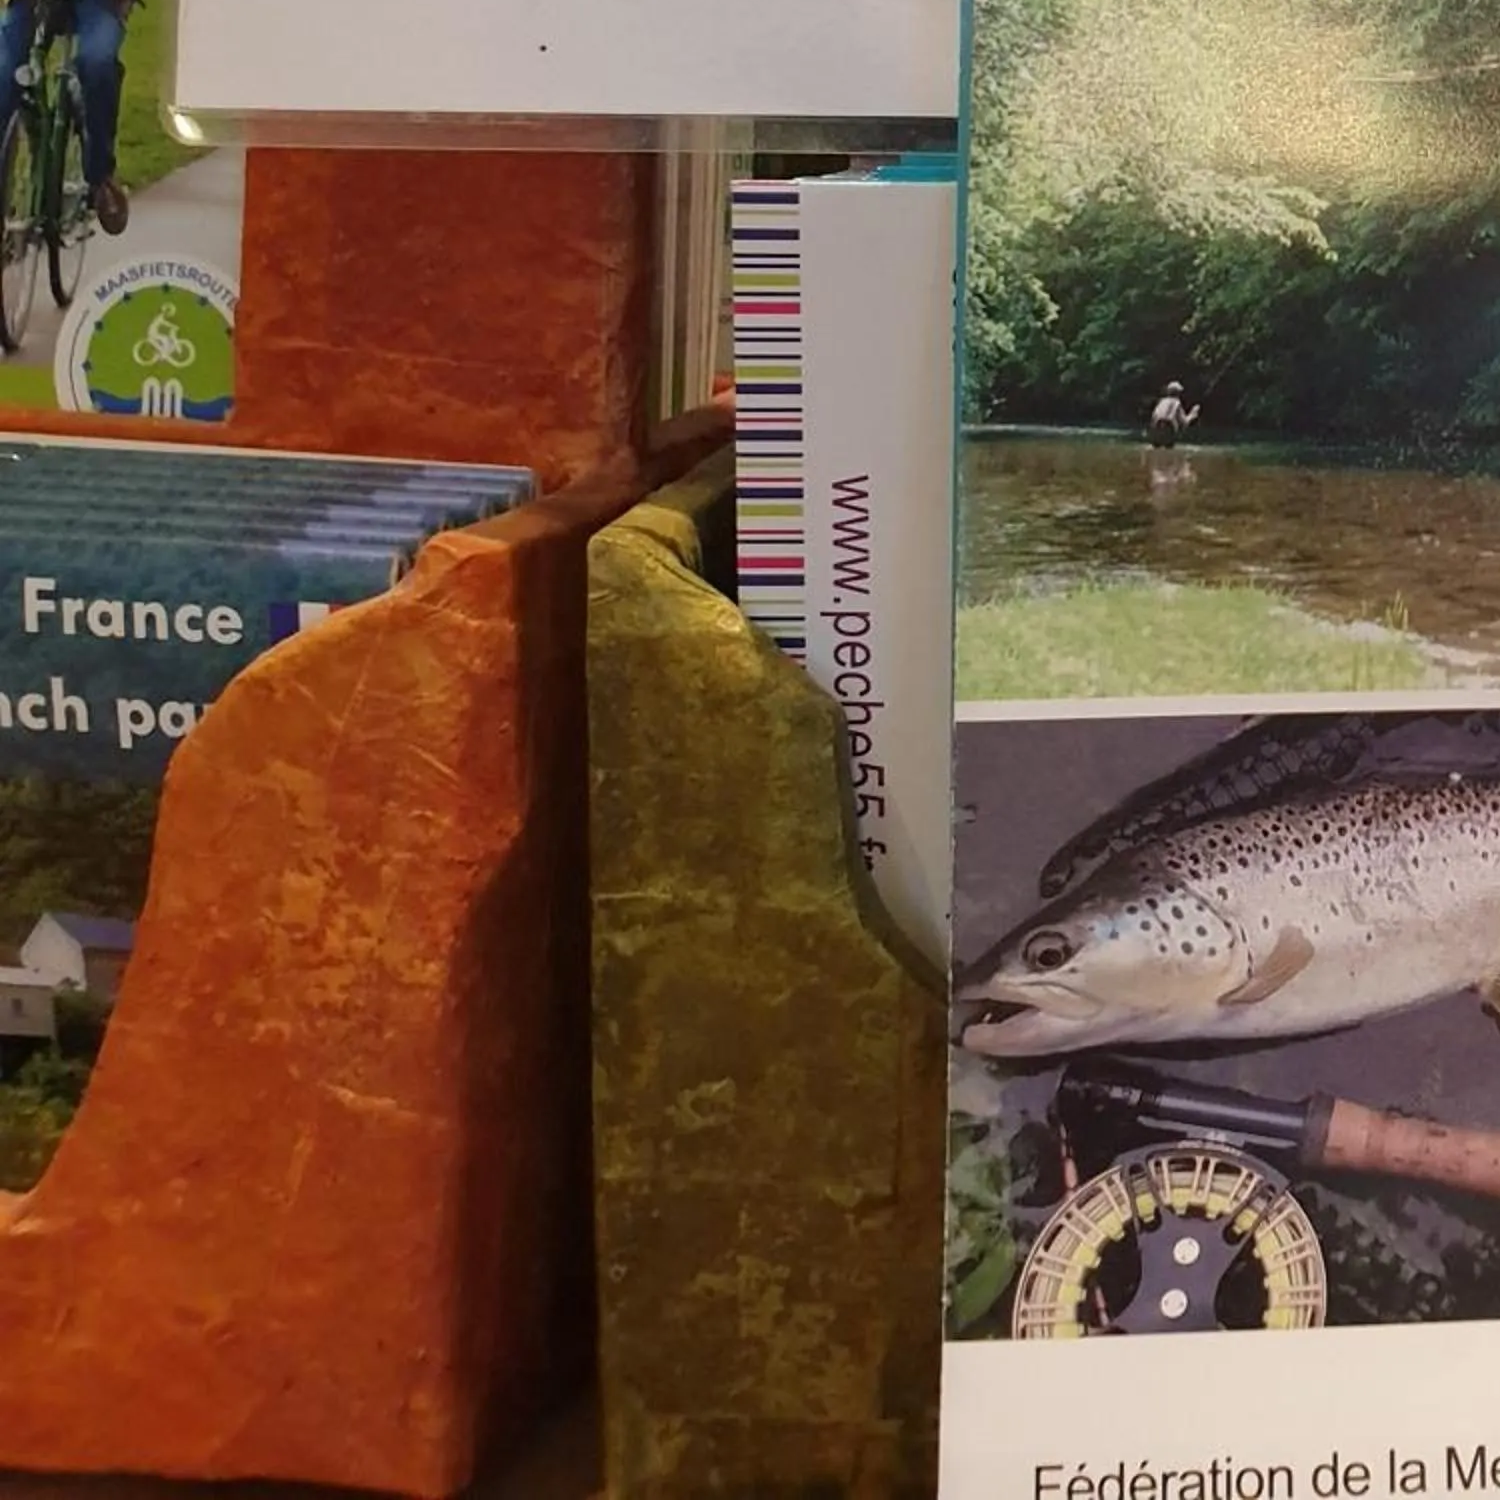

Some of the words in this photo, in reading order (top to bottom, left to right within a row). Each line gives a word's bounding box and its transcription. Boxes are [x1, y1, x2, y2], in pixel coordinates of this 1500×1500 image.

[23, 576, 244, 645] France
[1034, 1456, 1294, 1500] Fédération
[1311, 1451, 1371, 1498] de
[1388, 1448, 1427, 1494] la
